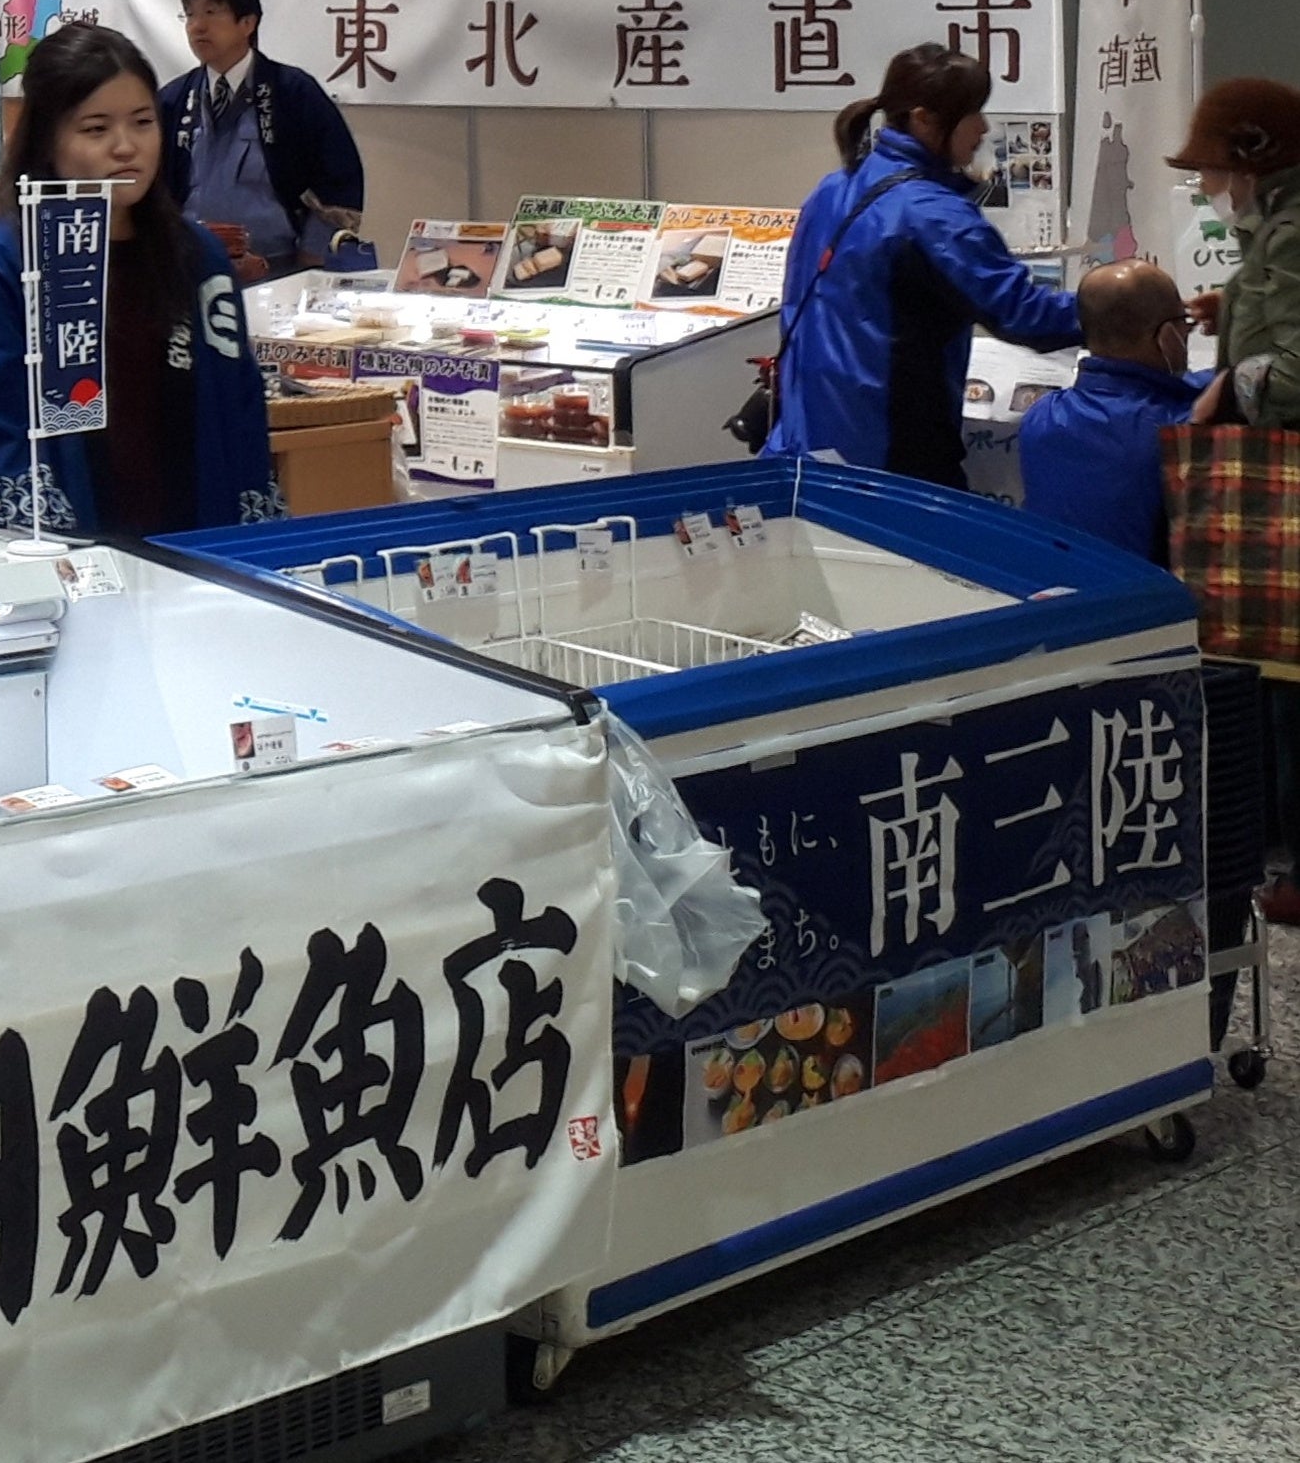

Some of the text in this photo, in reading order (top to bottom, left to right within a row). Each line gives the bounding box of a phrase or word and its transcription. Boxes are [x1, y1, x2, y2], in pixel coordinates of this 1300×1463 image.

[56, 208, 102, 369] 南三陸
[858, 699, 1184, 959] 南三陸
